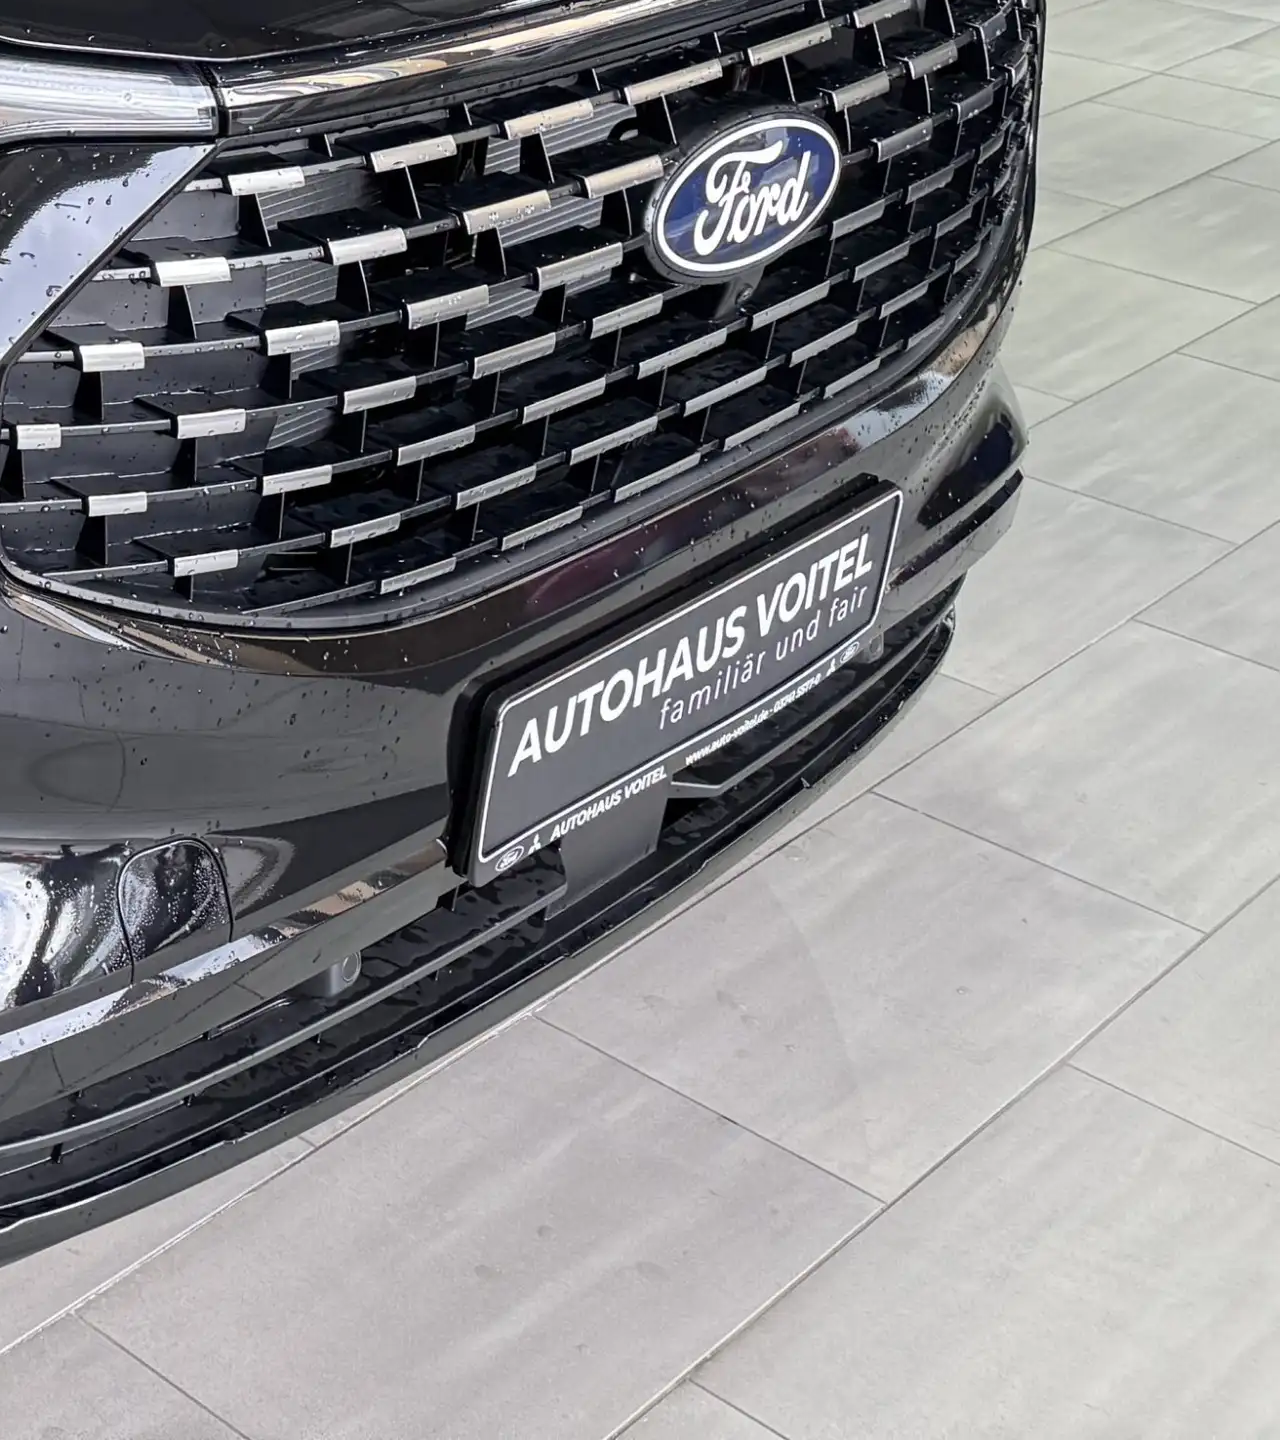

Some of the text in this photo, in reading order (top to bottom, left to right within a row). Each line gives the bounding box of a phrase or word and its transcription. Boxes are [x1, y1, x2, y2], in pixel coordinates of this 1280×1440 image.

[693, 140, 811, 256] Ford
[508, 533, 873, 777] AUTOHAUS VOITEL
[658, 651, 765, 730] familiär
[776, 620, 820, 660] und
[828, 586, 868, 626] fair
[549, 791, 623, 842] AUTOHAUS
[624, 765, 667, 799] VOITEL
